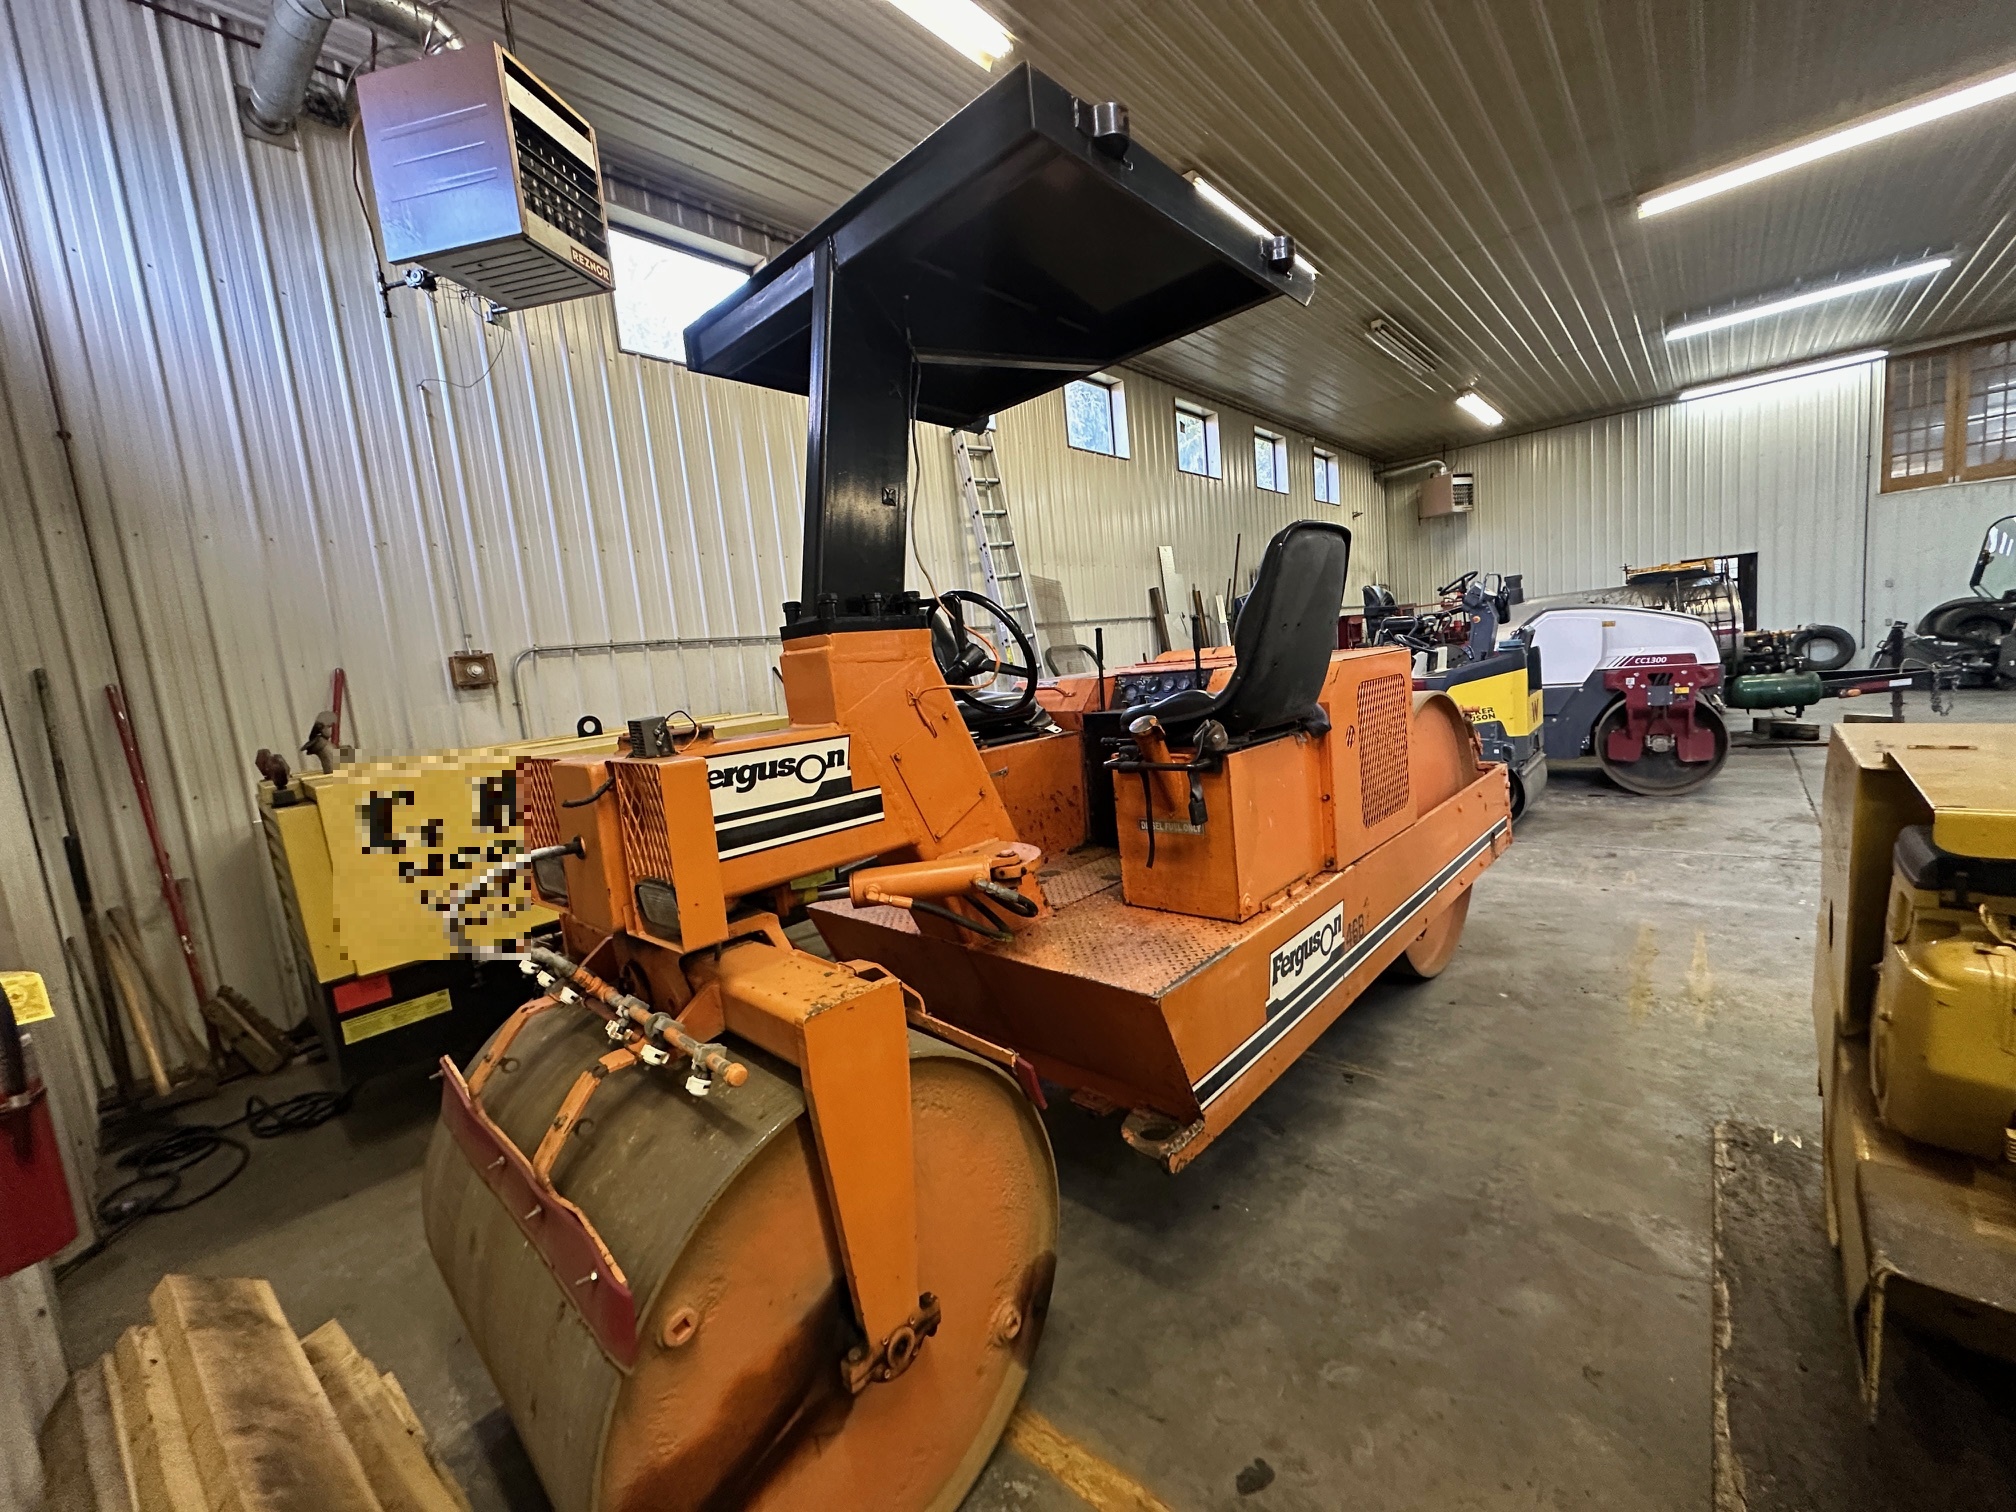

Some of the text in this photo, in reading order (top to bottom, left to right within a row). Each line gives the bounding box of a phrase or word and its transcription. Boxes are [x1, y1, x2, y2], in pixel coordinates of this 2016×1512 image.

[572, 249, 610, 281] REZNOR
[1634, 656, 1667, 664] CC1300
[707, 749, 845, 793] erguson
